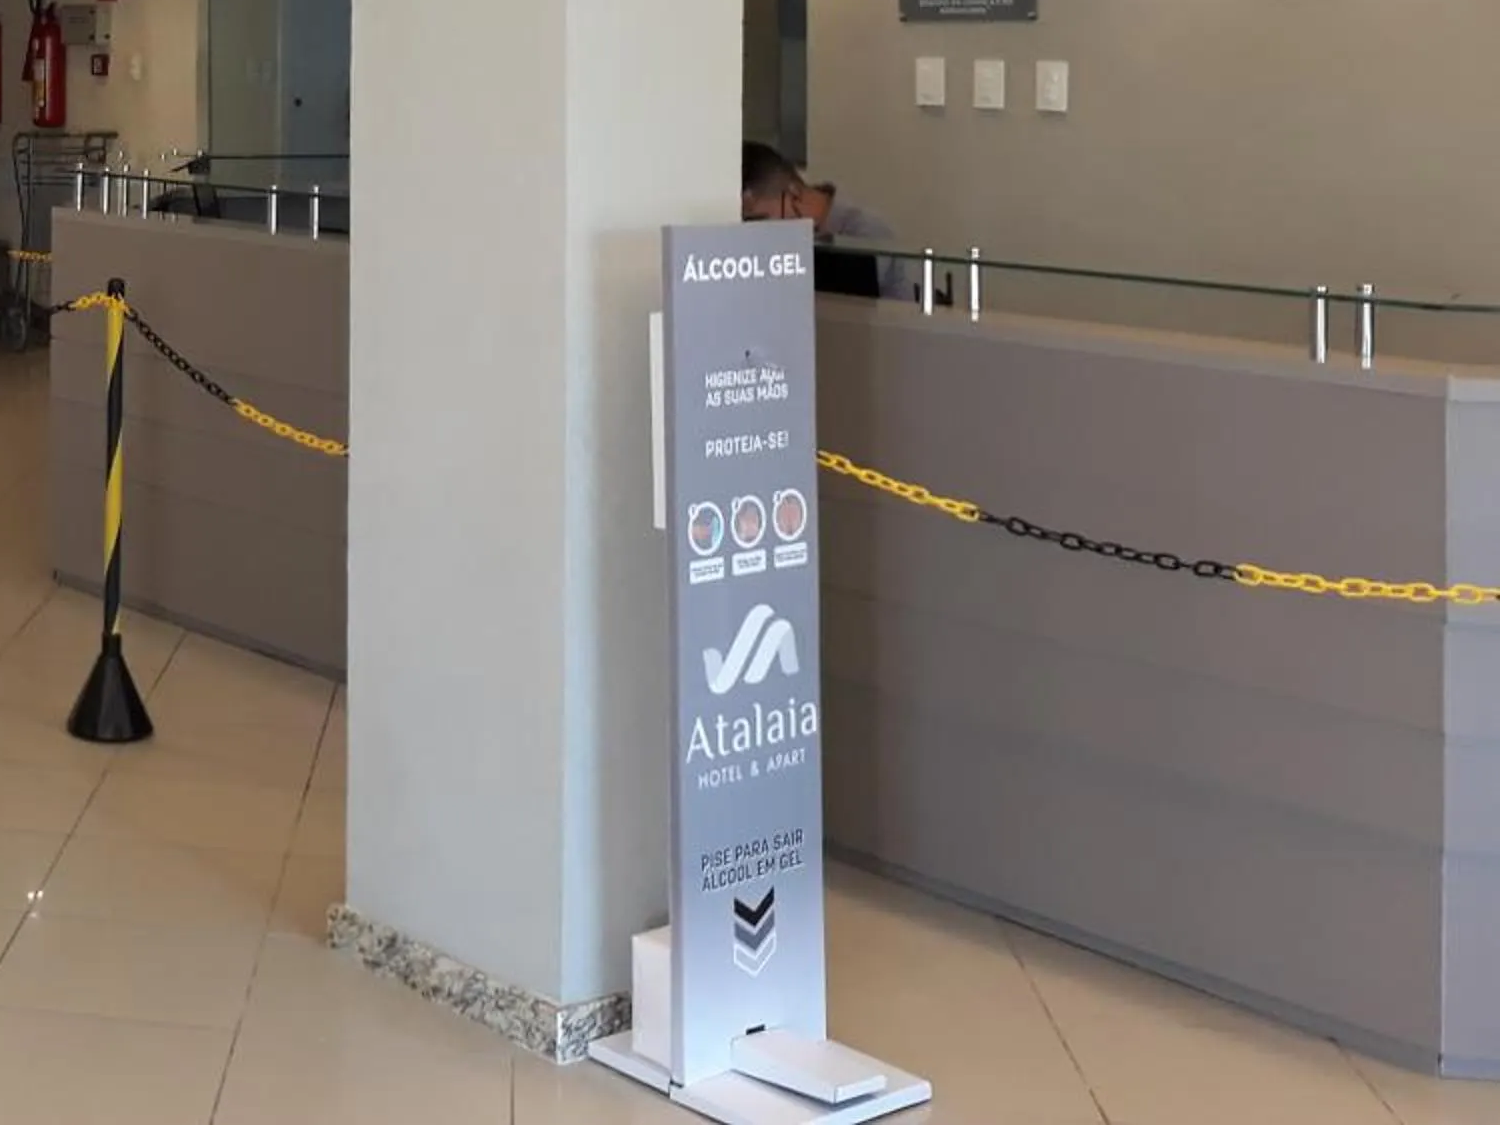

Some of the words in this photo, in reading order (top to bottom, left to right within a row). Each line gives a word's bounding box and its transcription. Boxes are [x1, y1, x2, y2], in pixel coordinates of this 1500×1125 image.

[683, 254, 765, 282] ÁLCOOL
[769, 252, 806, 276] GEL
[705, 368, 757, 390] HIGIENIZE
[706, 391, 721, 408] AS
[724, 386, 754, 406] SUAS
[705, 430, 789, 459] PROTEJA-SE!
[686, 697, 817, 764] Atalaia
[698, 764, 743, 790] HOTEL
[750, 760, 760, 777] &
[766, 747, 805, 774] APART
[701, 848, 732, 872] PISE
[735, 838, 769, 862] PARA
[772, 827, 803, 851] SAIR
[757, 856, 775, 876] EM
[780, 849, 803, 870] GEL
